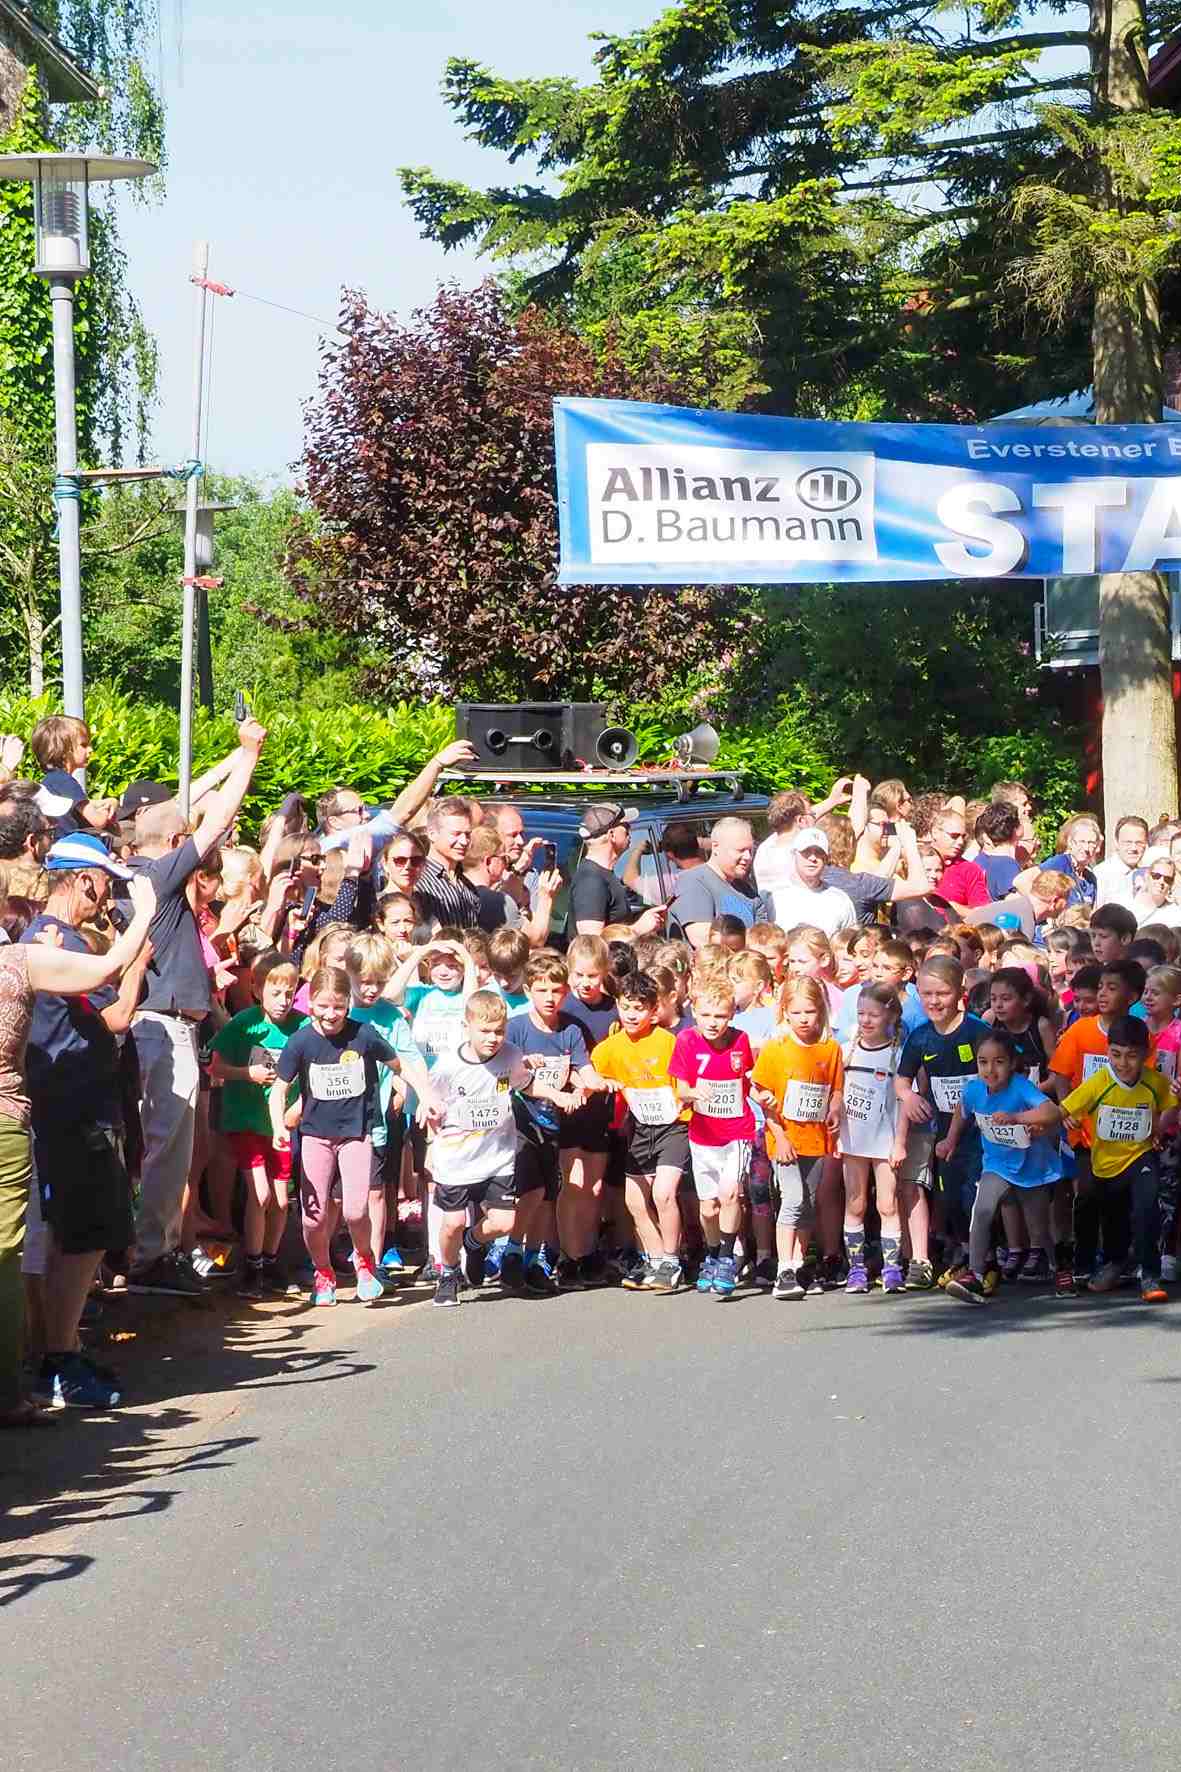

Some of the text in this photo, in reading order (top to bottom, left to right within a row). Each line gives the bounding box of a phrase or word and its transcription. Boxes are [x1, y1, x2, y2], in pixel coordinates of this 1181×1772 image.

[966, 438, 1157, 460] Everstener
[600, 466, 781, 504] Allianz
[602, 510, 863, 543] D. Baumann
[696, 1053, 711, 1075] 7
[538, 1070, 560, 1080] 576
[708, 1103, 734, 1114] bruns
[799, 1096, 823, 1109] 1136
[846, 1094, 872, 1111] 2673
[469, 1107, 500, 1118] 1475
[796, 1106, 819, 1119] bruns
[846, 1104, 869, 1121] bruns
[1111, 1119, 1140, 1131] 1128
[1110, 1129, 1136, 1141] bruns
